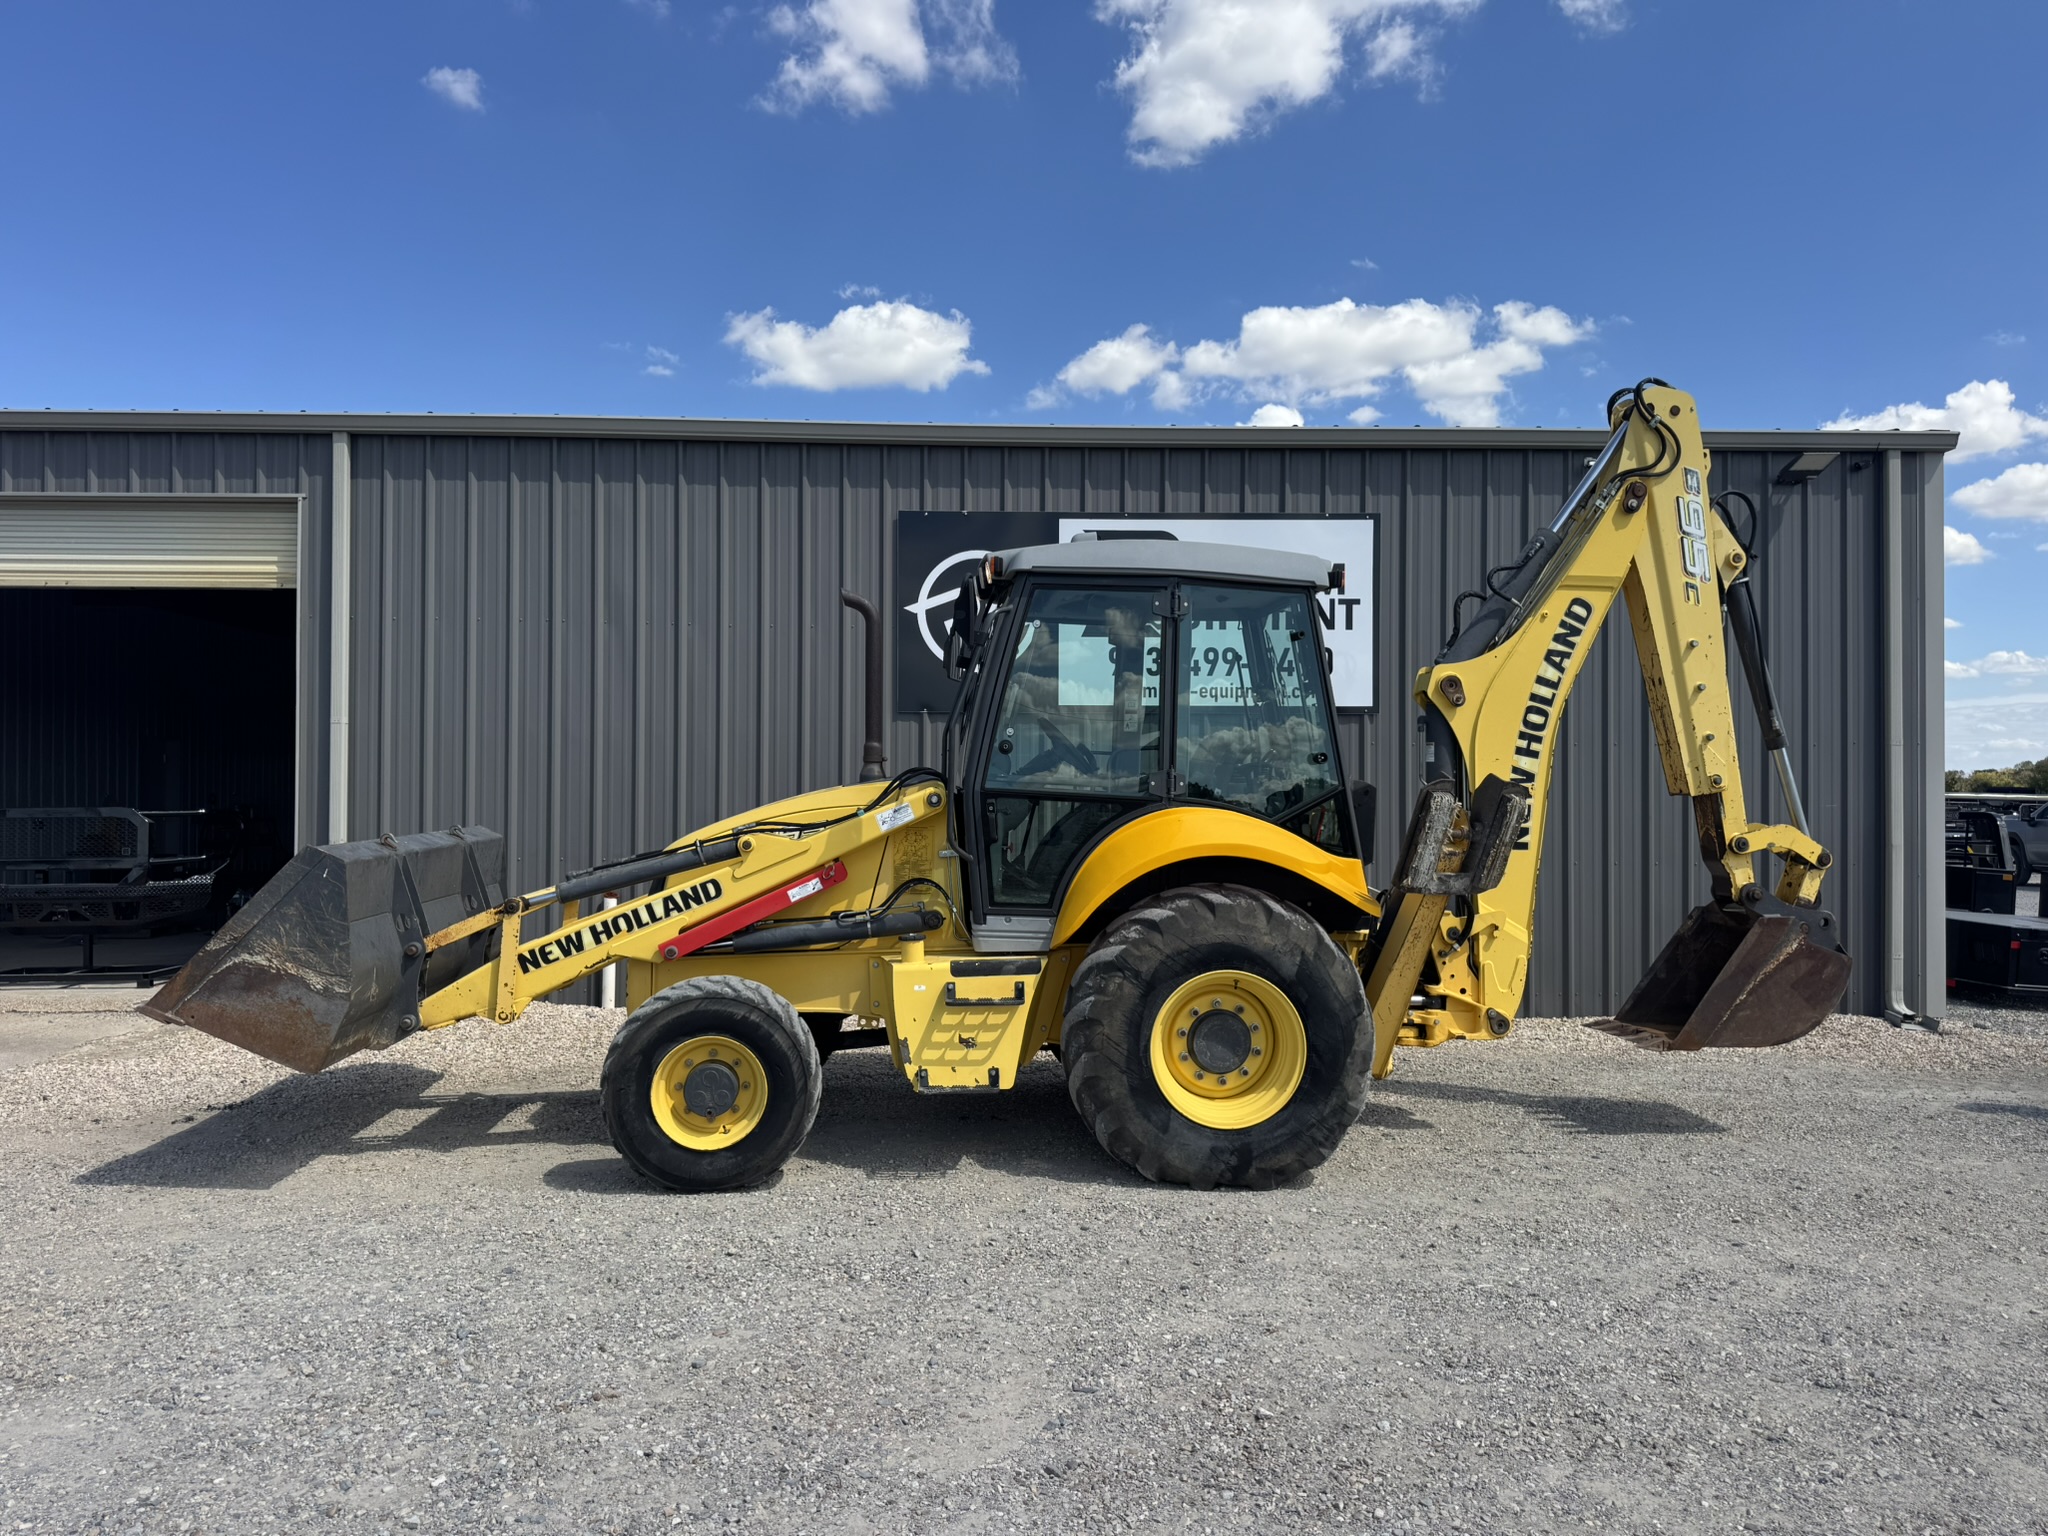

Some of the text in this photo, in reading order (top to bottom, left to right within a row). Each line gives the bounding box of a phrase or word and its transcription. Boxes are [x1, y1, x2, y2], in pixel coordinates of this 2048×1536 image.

[1510, 597, 1594, 850] NW HOLLAND
[517, 928, 585, 974] NEW
[590, 878, 723, 945] HOLLAND
